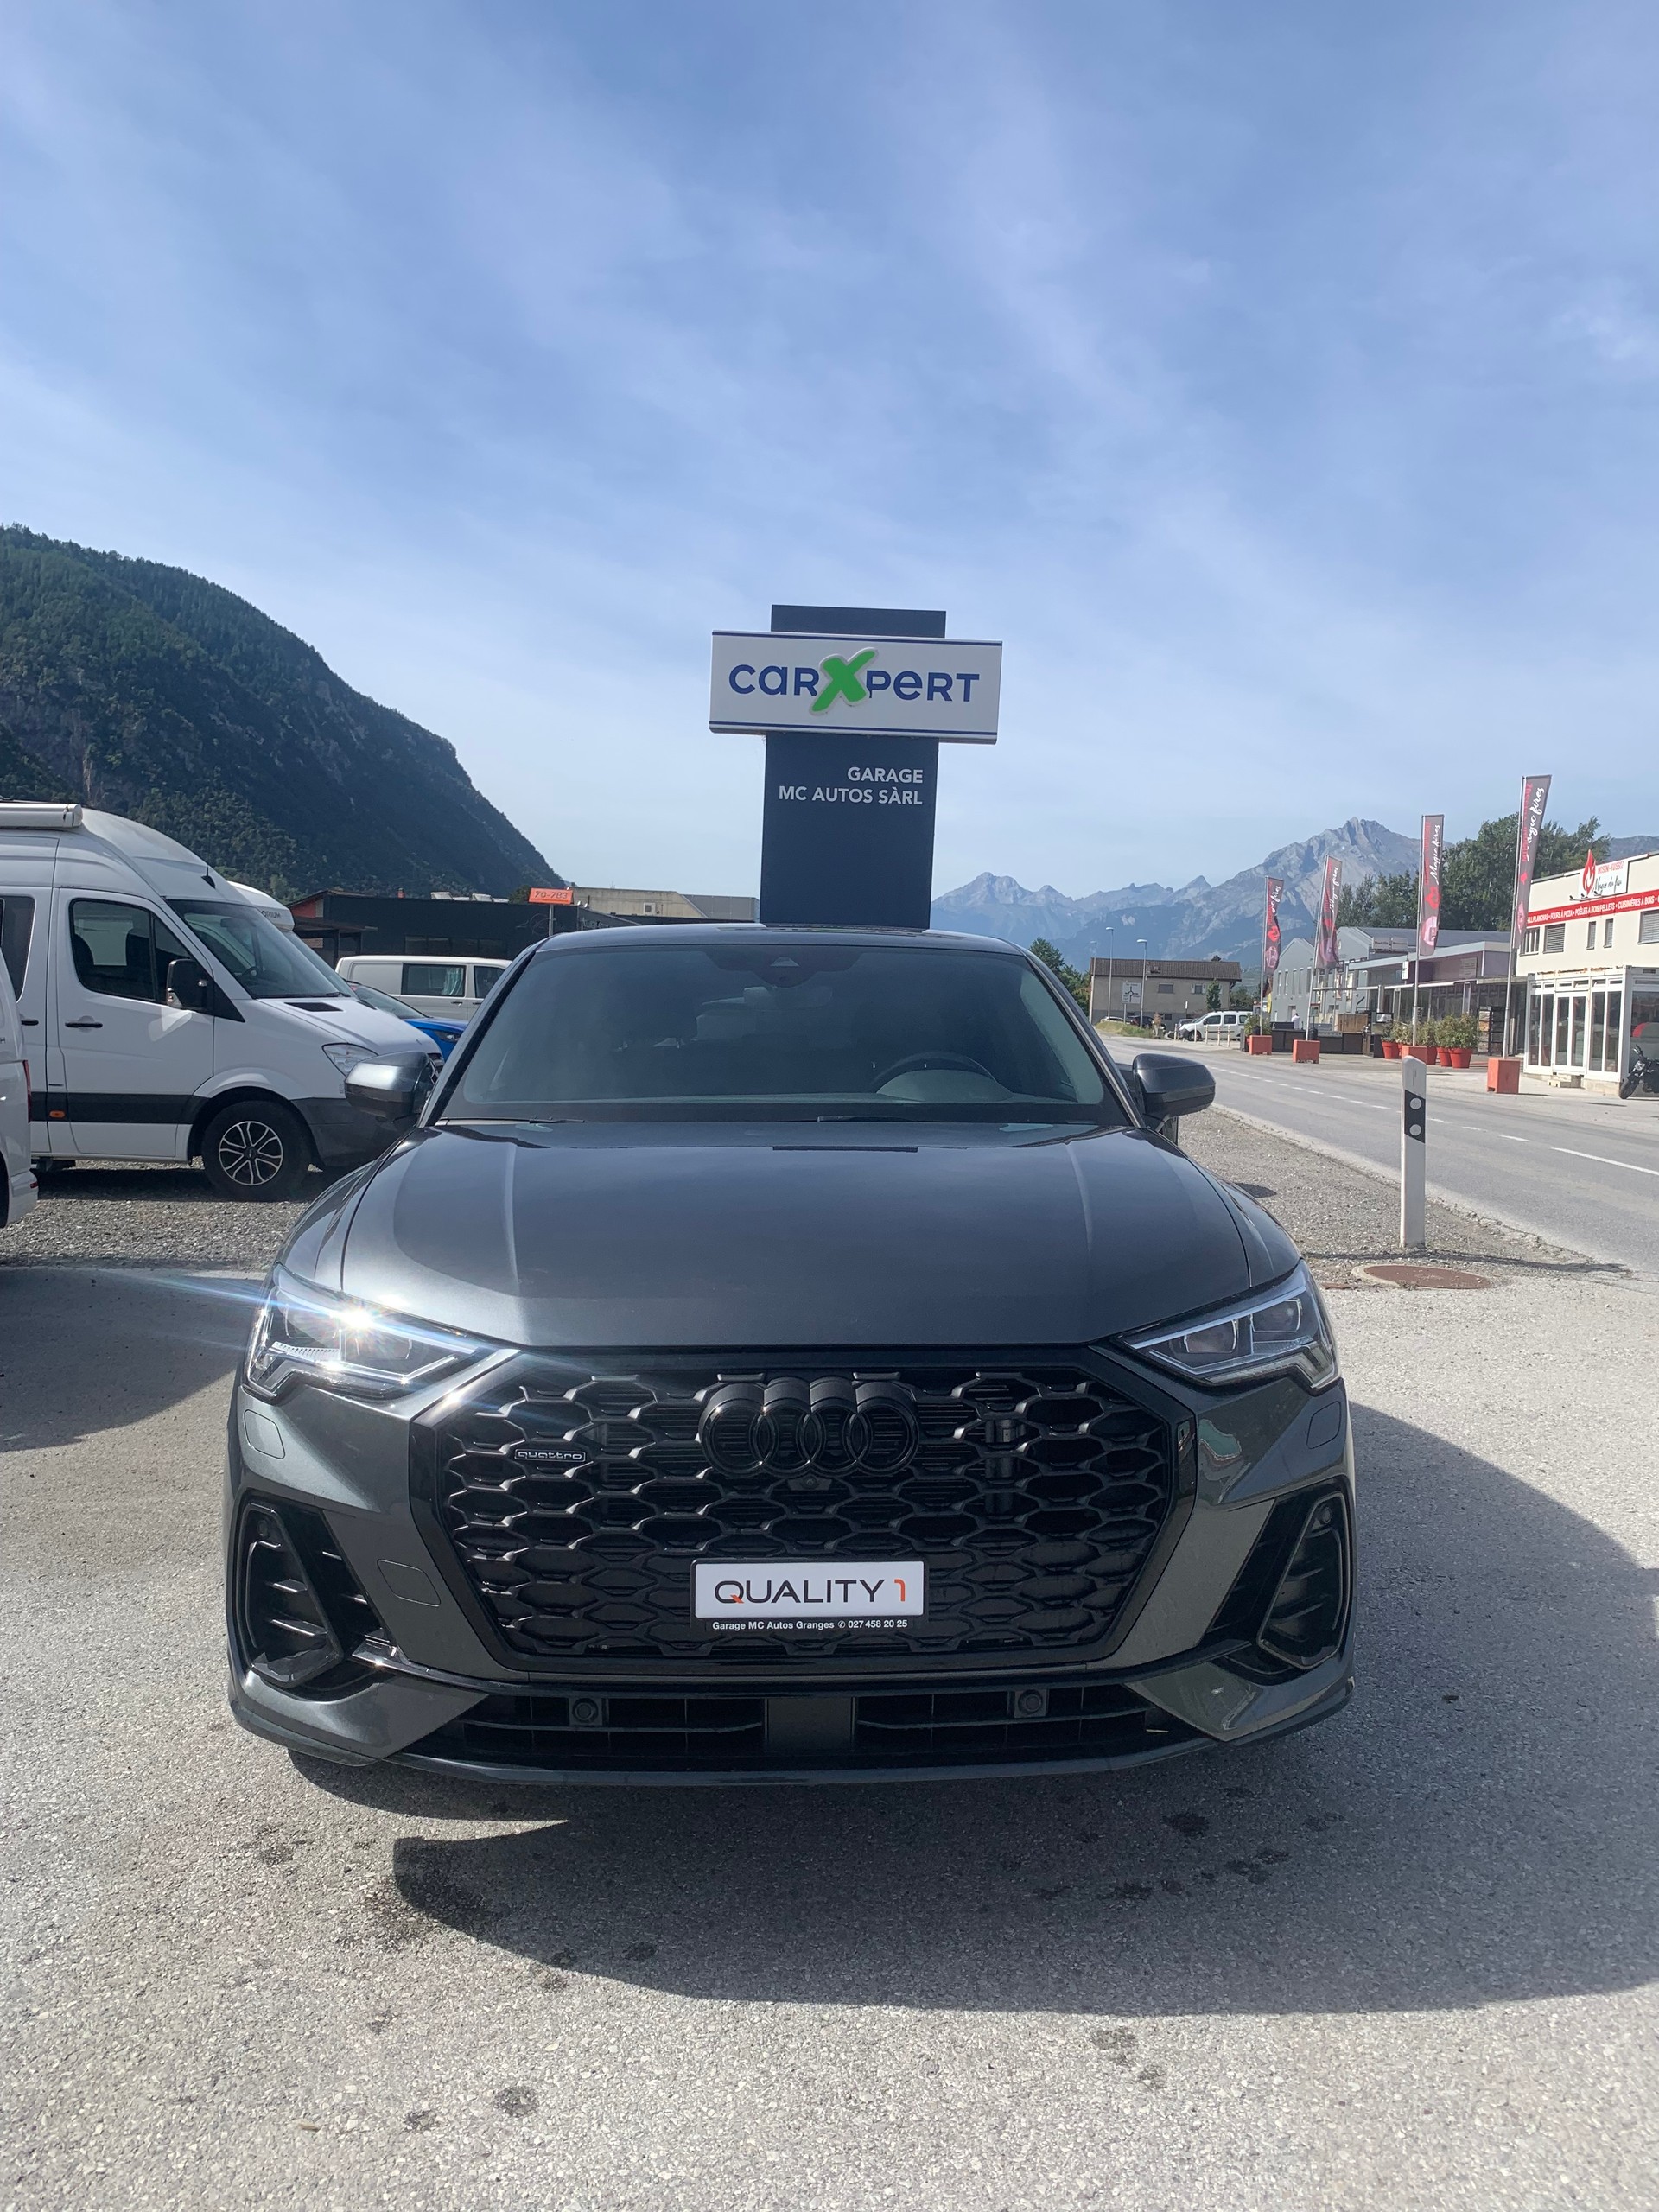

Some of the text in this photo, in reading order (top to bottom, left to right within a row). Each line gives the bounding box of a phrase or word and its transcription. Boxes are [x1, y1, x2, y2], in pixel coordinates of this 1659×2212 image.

[847, 766, 924, 784] GARAGE
[779, 785, 923, 804] MC AUTOS SÀRL
[715, 1579, 885, 1604] QUALITY
[712, 1622, 746, 1631] Garage
[748, 1621, 765, 1630] MC
[766, 1621, 793, 1630] Autos
[796, 1620, 835, 1630] Granges
[896, 1619, 907, 1628] 25
